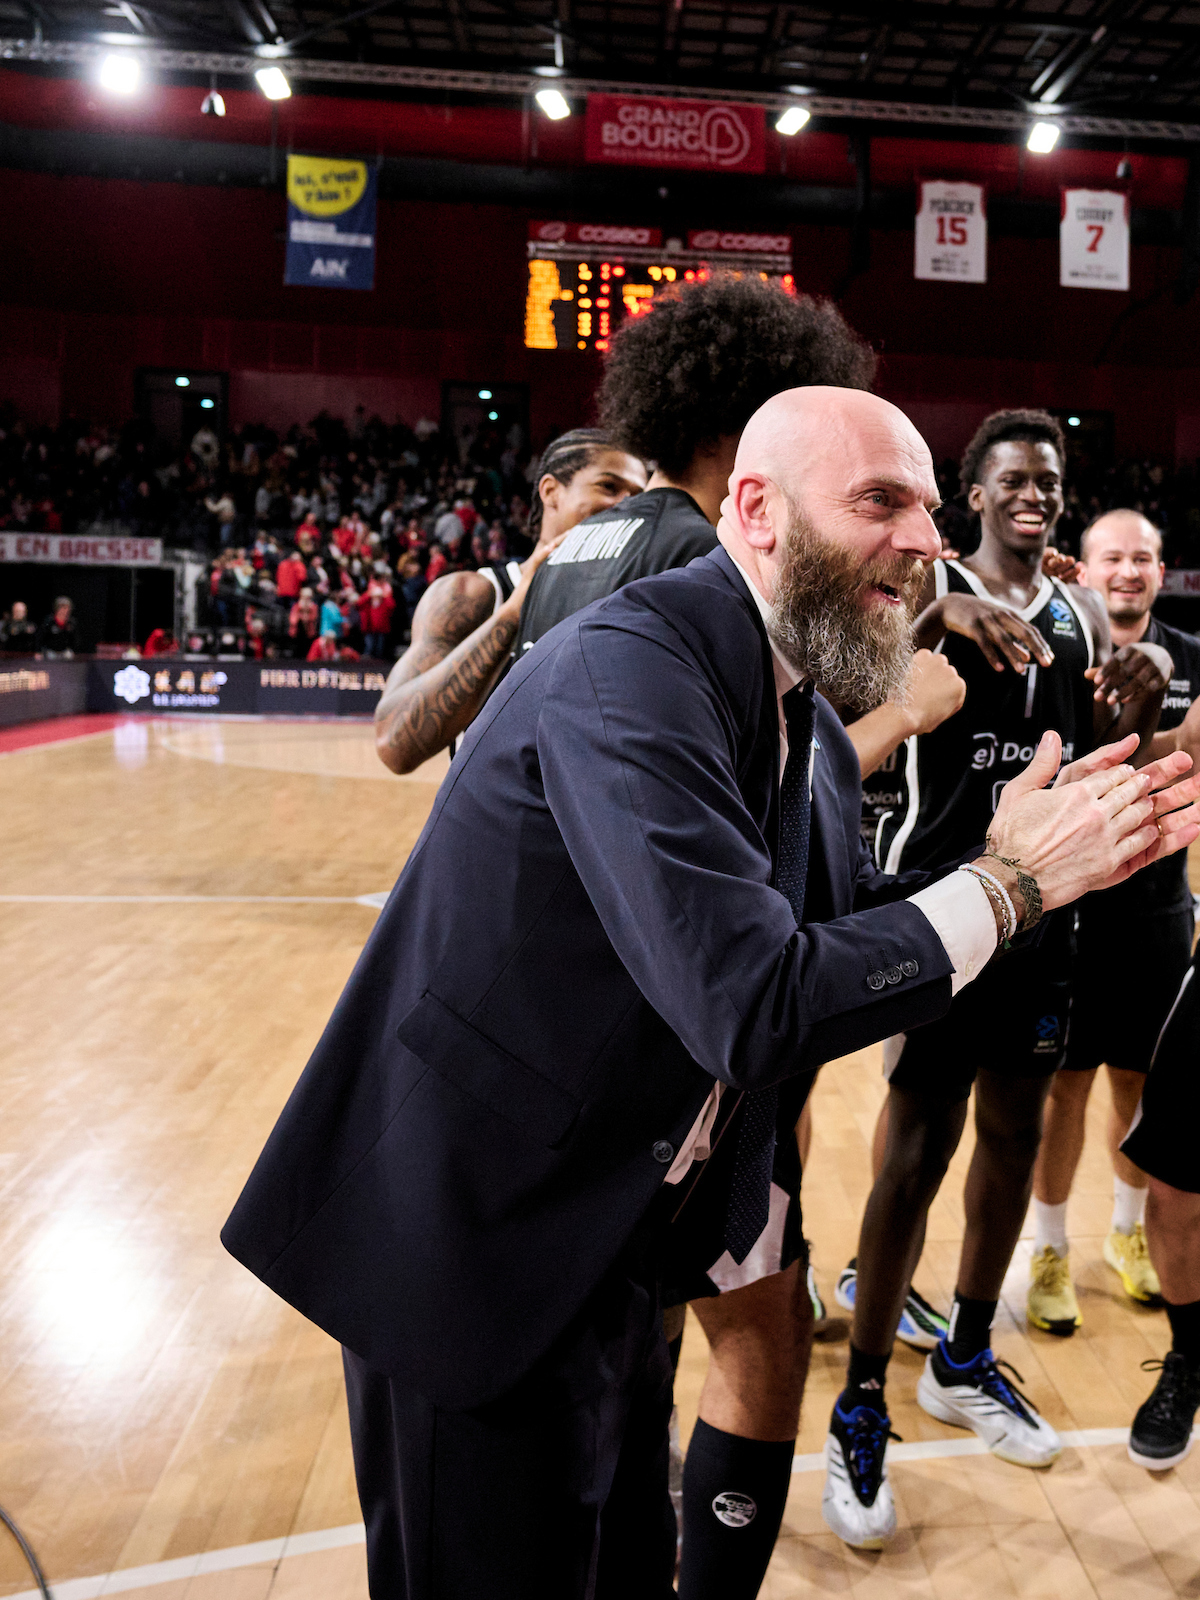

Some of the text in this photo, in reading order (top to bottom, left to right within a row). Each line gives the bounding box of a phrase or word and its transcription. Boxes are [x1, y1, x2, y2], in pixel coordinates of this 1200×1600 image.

[617, 105, 700, 127] GRAND
[602, 122, 700, 150] BOURG
[936, 215, 968, 246] 15
[1086, 224, 1104, 253] 7
